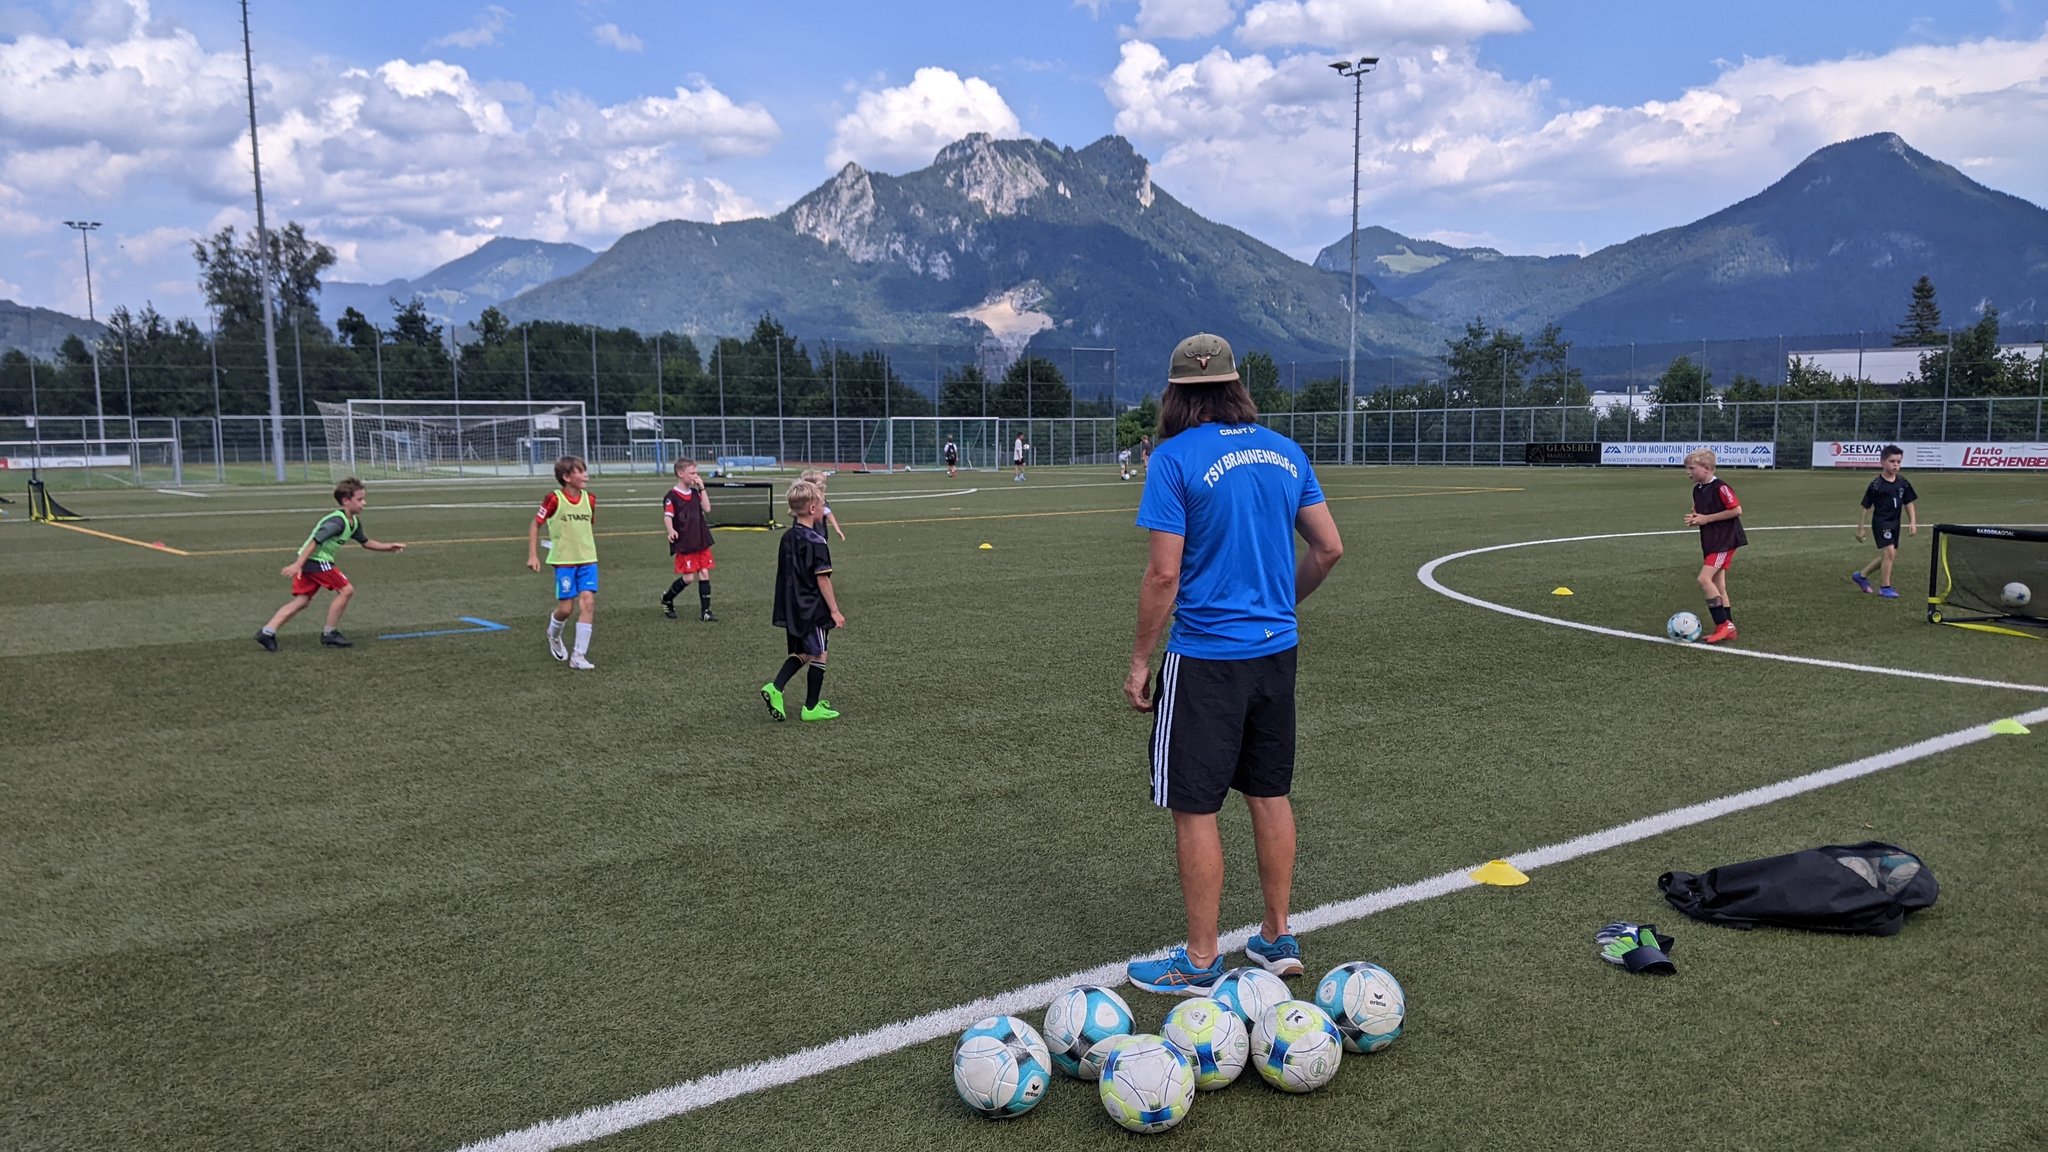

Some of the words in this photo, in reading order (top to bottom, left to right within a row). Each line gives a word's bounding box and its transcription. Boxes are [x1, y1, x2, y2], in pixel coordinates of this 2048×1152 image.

[1219, 427, 1248, 436] CRAFT
[1546, 444, 1594, 452] GLASEREI
[1624, 445, 1636, 454] TOP
[1638, 445, 1647, 454] ON
[1648, 445, 1683, 454] MOUNTAIN
[1710, 445, 1722, 454] SKI
[1724, 446, 1749, 454] Stores
[1842, 444, 1887, 454] SEEWA
[1973, 447, 2003, 455] Auto
[1717, 456, 1742, 464] Service
[1961, 447, 2048, 467] LERCHENBE
[1203, 460, 1225, 488] TSV
[1222, 449, 1298, 479] BRANNENBURG
